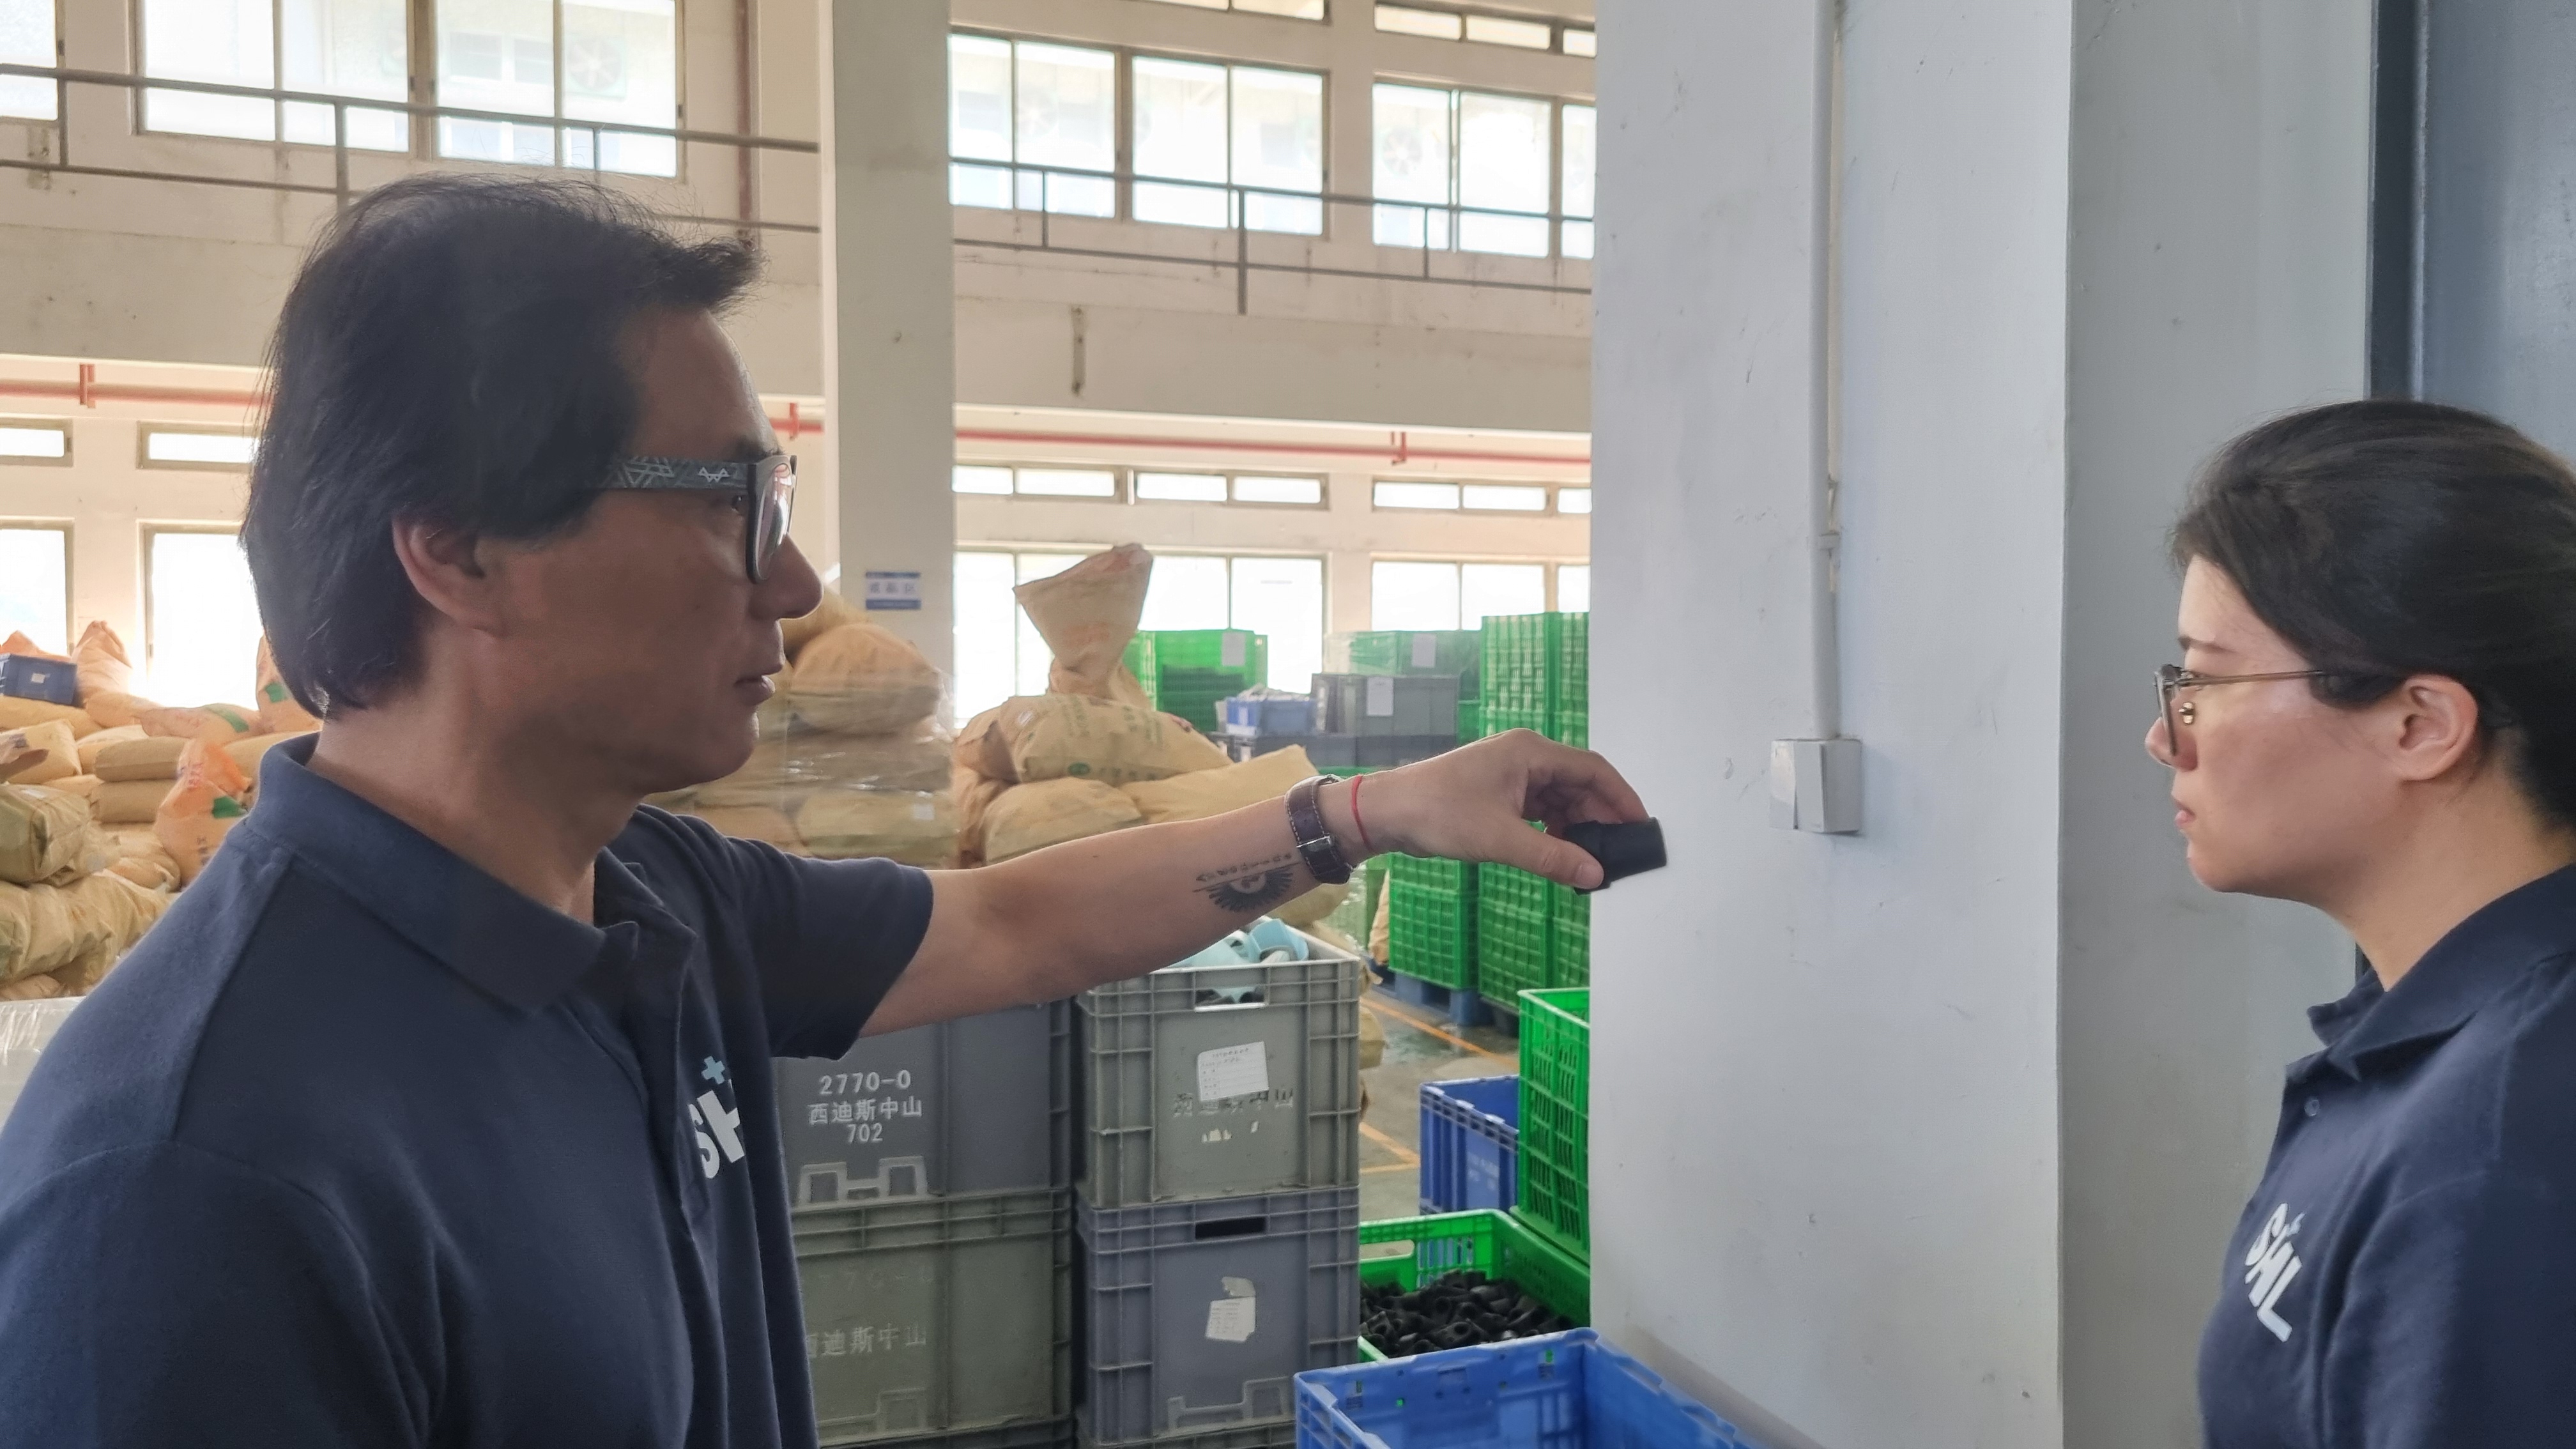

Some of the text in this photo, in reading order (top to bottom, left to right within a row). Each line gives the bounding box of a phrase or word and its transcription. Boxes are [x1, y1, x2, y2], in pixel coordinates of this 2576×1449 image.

[818, 1069, 912, 1095] 2770-0
[807, 1095, 923, 1126] 西迪斯中山
[847, 1123, 884, 1144] 702
[2244, 1202, 2303, 1342] SHL
